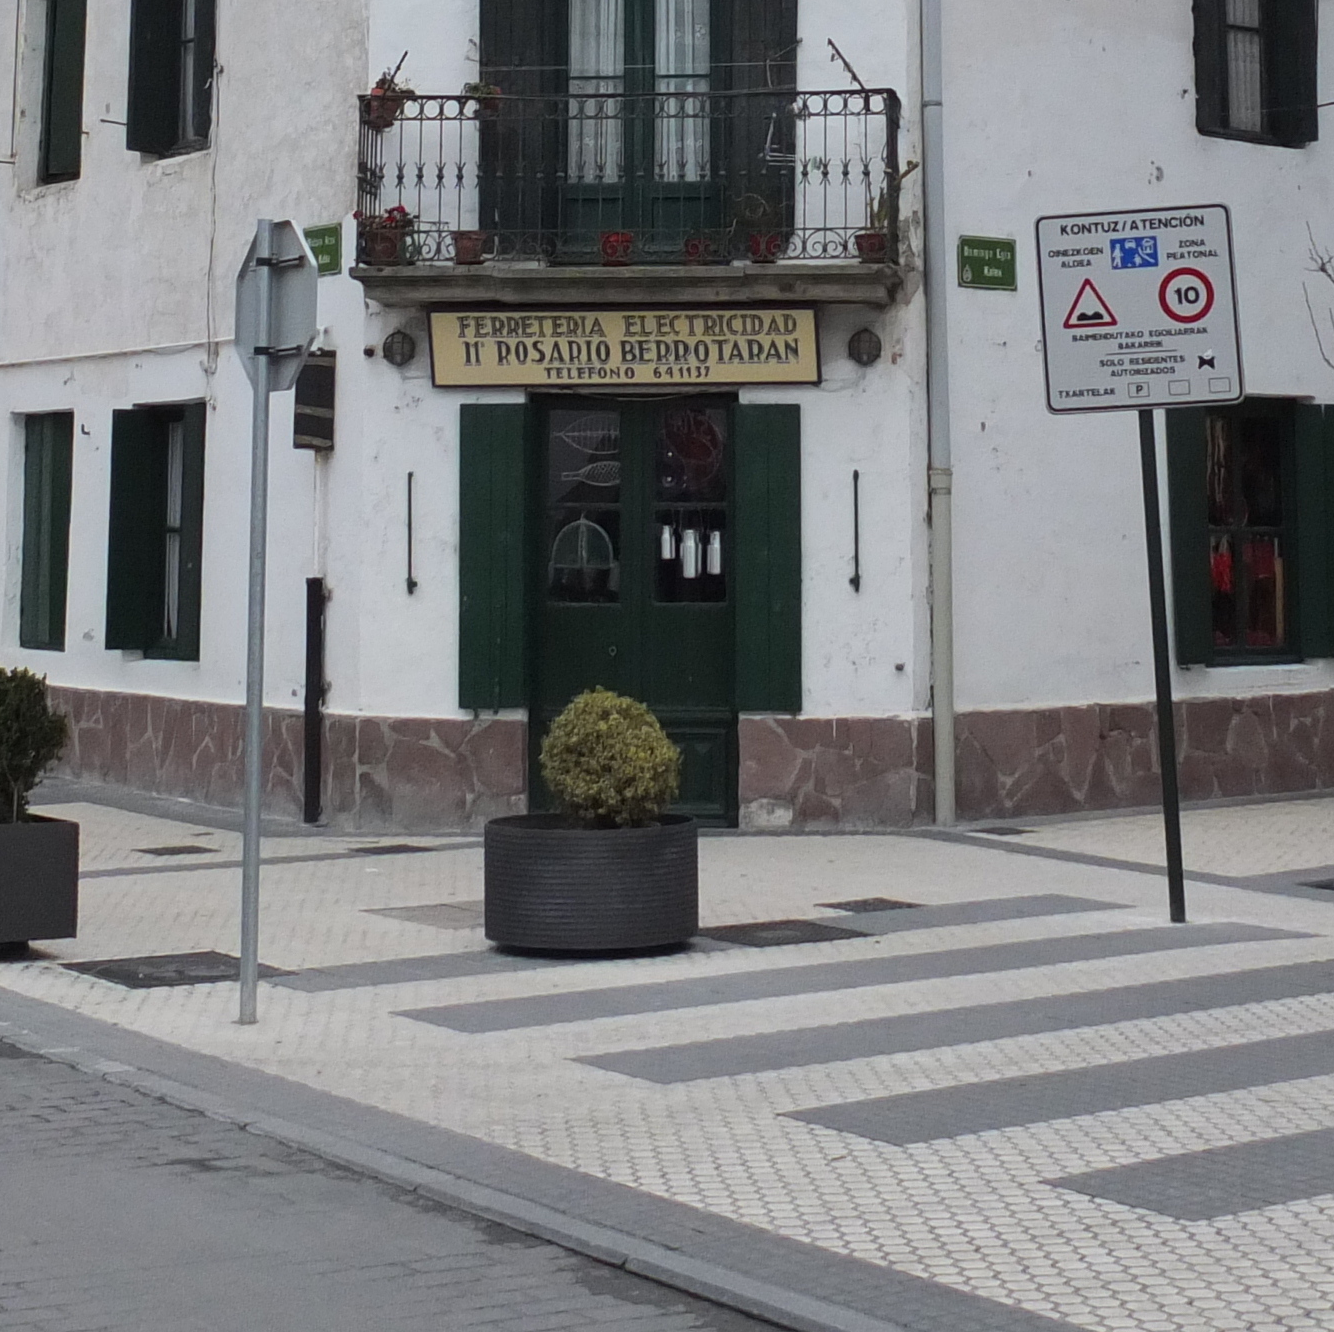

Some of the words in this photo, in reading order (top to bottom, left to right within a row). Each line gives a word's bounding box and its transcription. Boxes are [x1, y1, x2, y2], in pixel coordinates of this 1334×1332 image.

[1060, 221, 1119, 235] KONTUZ
[1130, 213, 1205, 231] ATENCIÓN
[1178, 239, 1206, 248] ZONA
[1167, 250, 1219, 260] PEATONAL
[1174, 286, 1200, 304] 10
[457, 315, 607, 339] FERRETERIA
[621, 313, 798, 337] ELECTRICIDAD
[496, 339, 611, 366] ROSARIO
[619, 337, 801, 365] BERROTARAN
[1099, 359, 1124, 367] SOLO
[1129, 355, 1185, 365] RESIDENTES
[544, 366, 636, 380] TELEFONO
[653, 365, 711, 380] 641137
[1110, 366, 1176, 377] AUTORIZADOS
[1135, 385, 1143, 395] P
